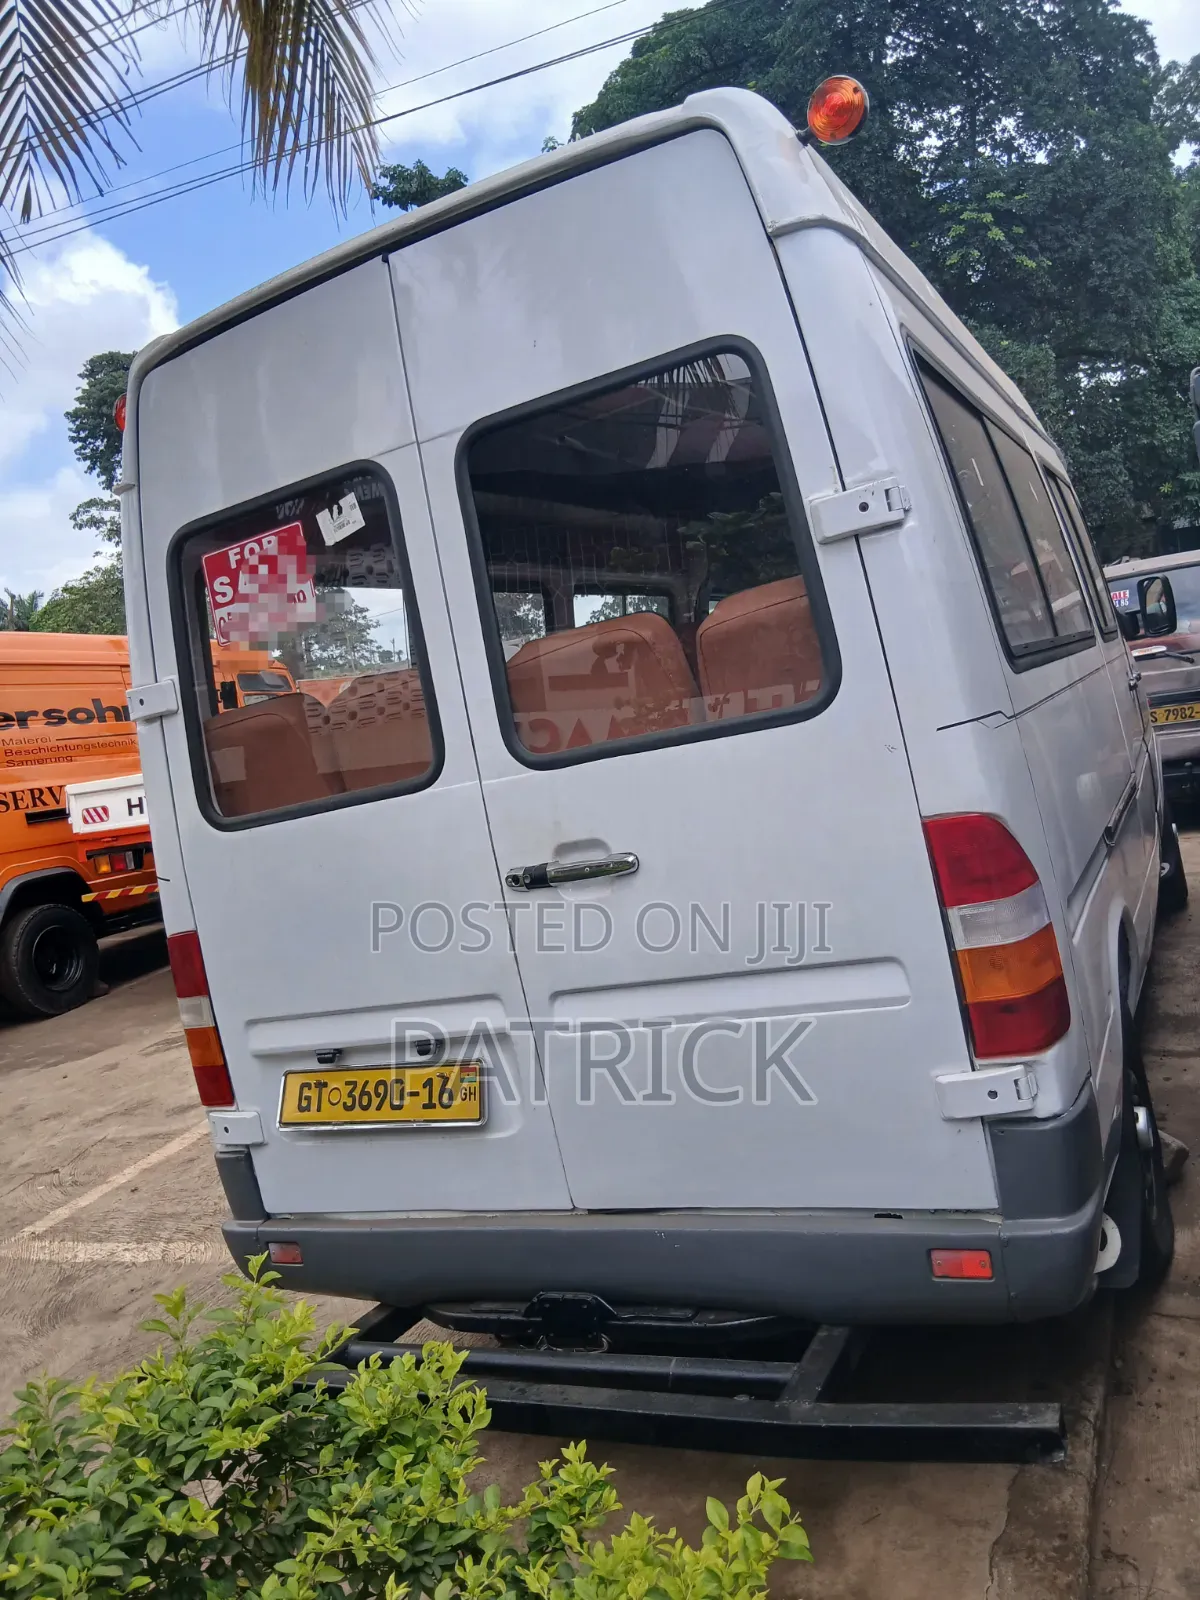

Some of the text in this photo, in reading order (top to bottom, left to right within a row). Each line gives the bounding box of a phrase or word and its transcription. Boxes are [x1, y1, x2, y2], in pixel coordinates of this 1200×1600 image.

[1, 736, 52, 747] Malerei
[4, 738, 137, 757] Beschichtungstechnik
[6, 755, 73, 768] Sanierung
[127, 796, 147, 816] H
[297, 1080, 328, 1113] GT
[460, 1086, 477, 1102] GH
